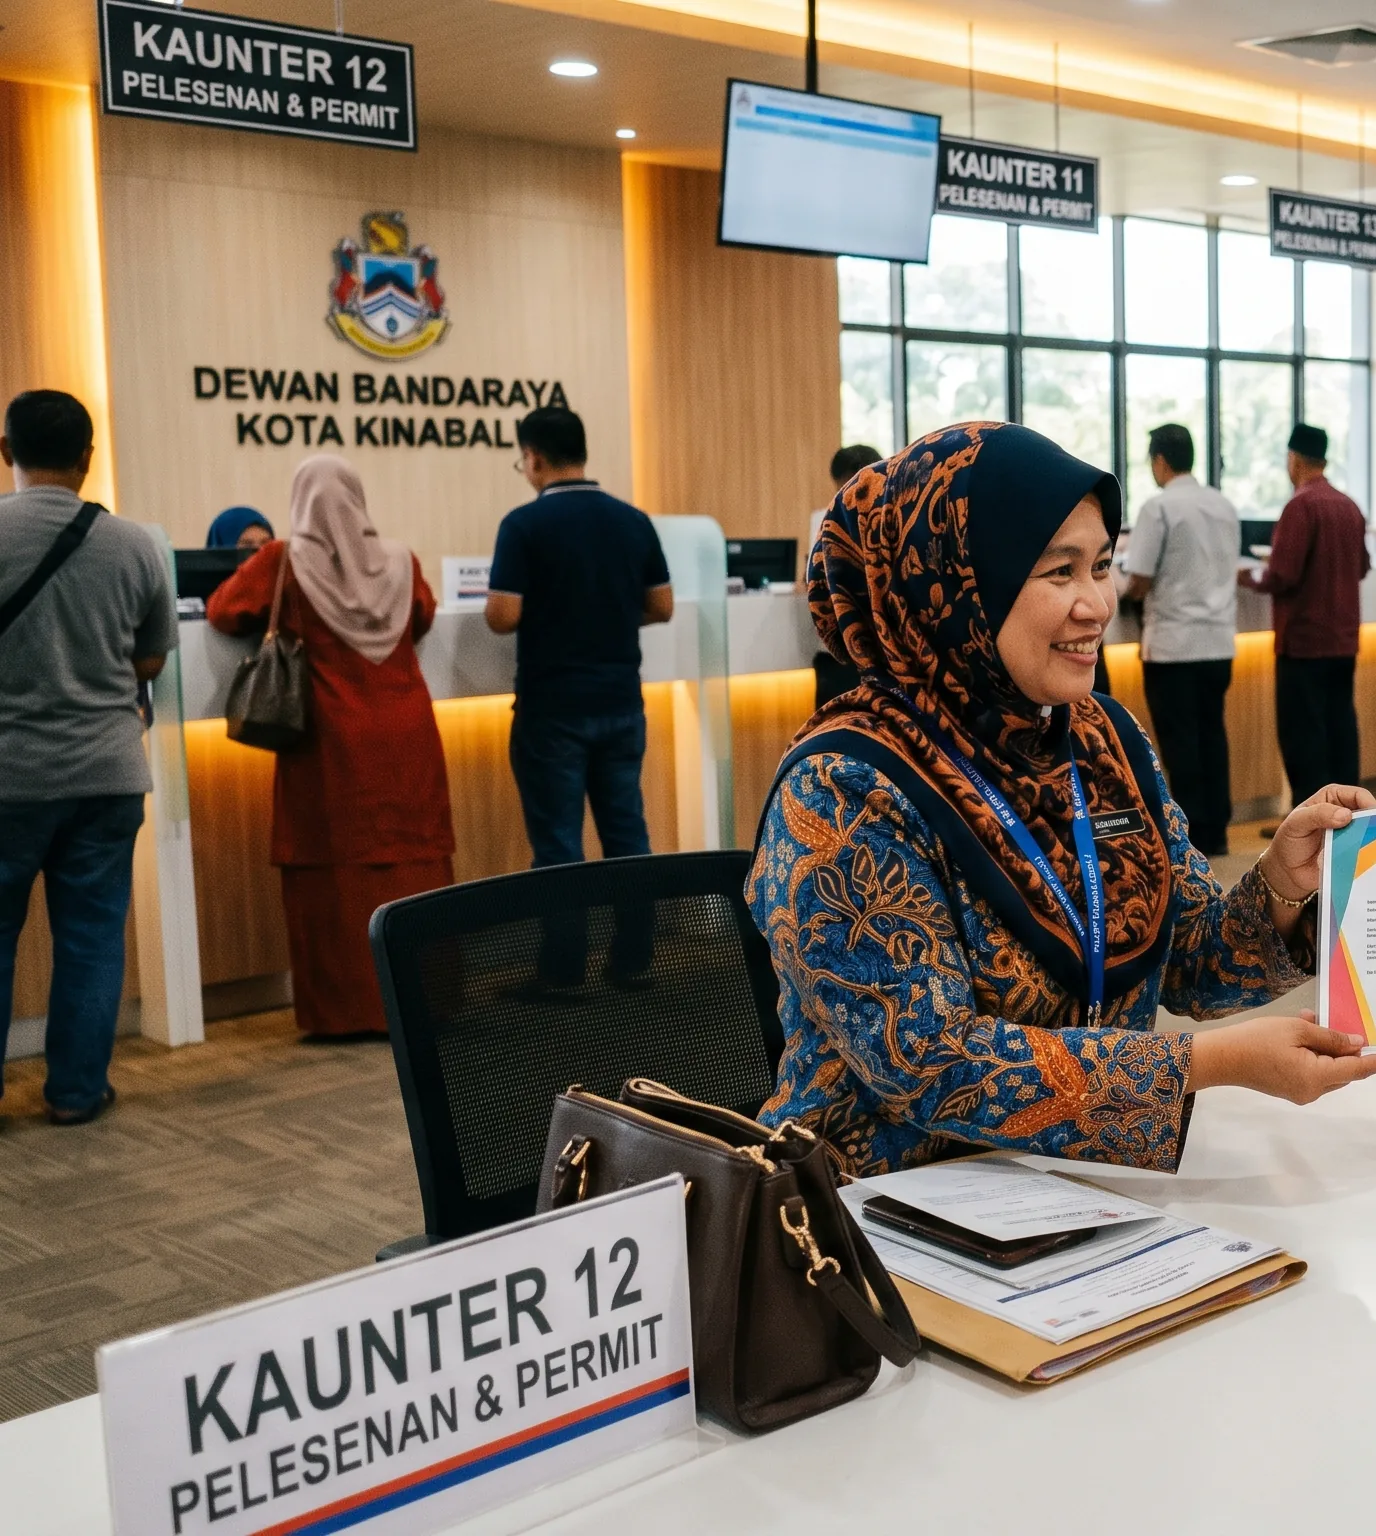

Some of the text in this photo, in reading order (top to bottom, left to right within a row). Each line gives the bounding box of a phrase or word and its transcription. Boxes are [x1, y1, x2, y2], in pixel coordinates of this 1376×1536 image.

[133, 21, 388, 93] KAUNTER 12
[122, 70, 400, 131] PELESENAN & PERMIT
[946, 148, 1084, 194] KAUNTER 11
[939, 184, 1093, 222] PELESENAN & PERMIT
[1278, 200, 1361, 235] KAUNTER
[194, 366, 569, 409] DEWAN BANDARAYA
[236, 413, 522, 448] KOTA KINABAL
[184, 1235, 645, 1456] KAUNTER 12
[170, 1312, 665, 1535] PELESENAN & PERMIT
